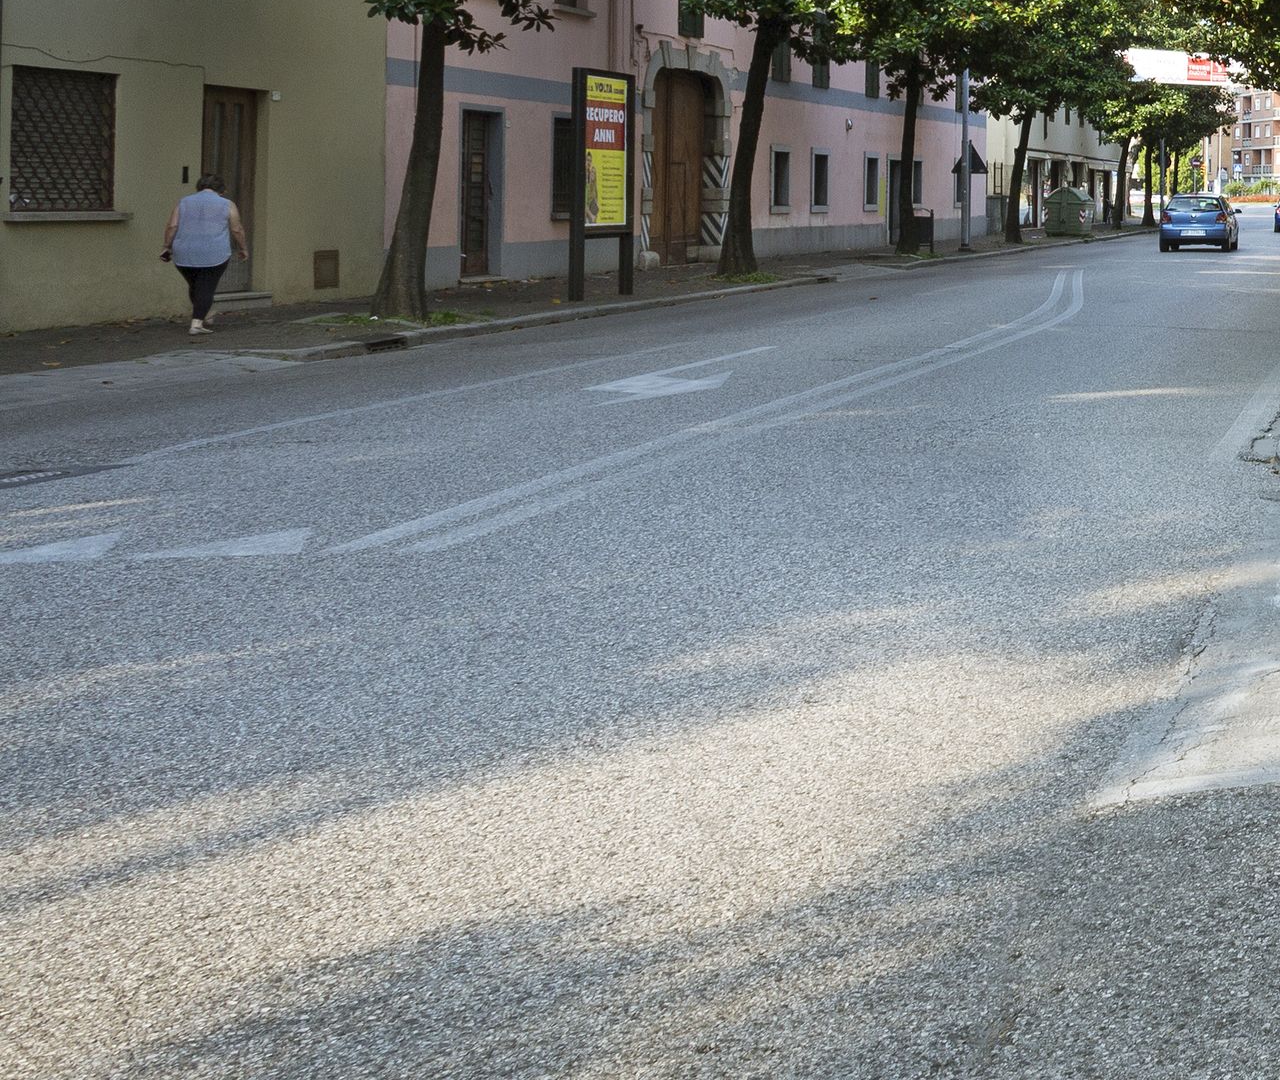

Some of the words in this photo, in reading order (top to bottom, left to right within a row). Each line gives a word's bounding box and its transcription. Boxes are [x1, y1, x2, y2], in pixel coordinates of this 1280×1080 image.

[594, 82, 613, 93] VOLTA
[586, 107, 625, 123] RECUPERO
[593, 128, 615, 143] ANNI
